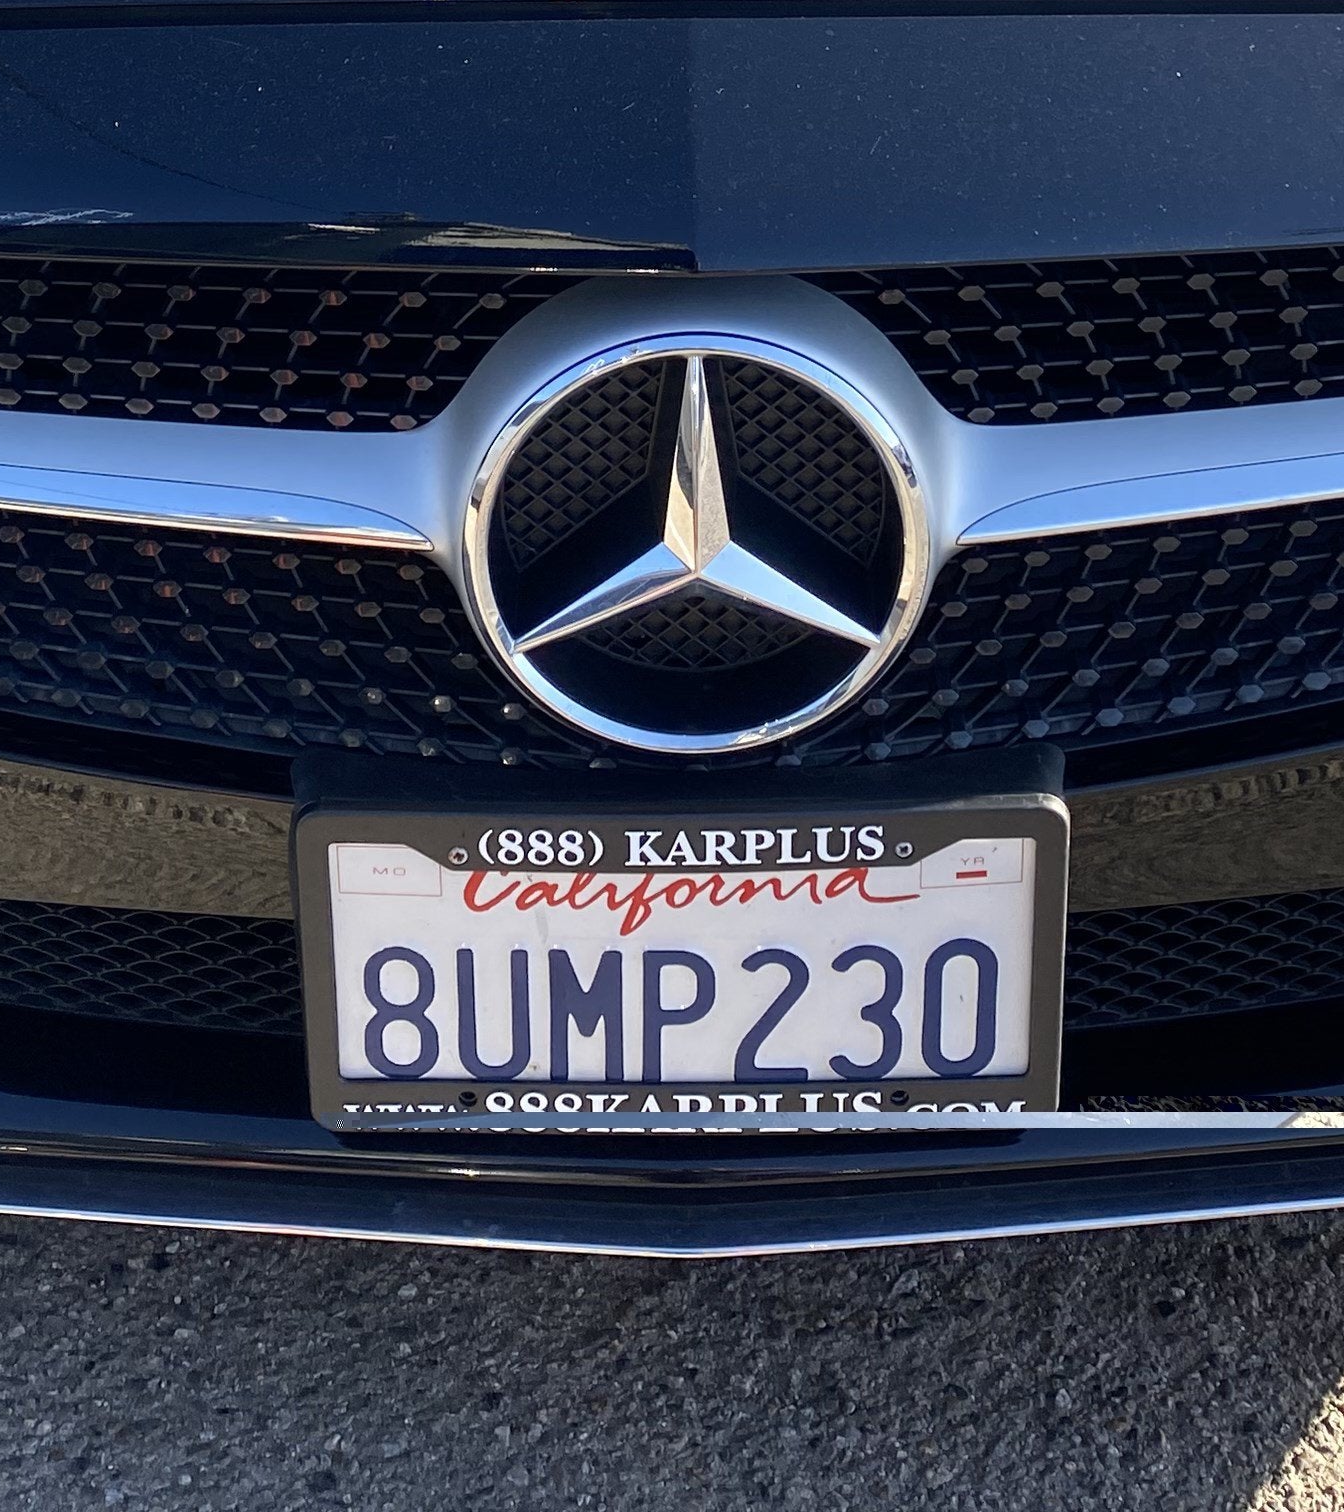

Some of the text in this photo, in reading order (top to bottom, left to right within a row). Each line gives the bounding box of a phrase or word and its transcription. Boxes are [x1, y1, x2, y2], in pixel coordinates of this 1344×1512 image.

[371, 866, 408, 877] MO
[477, 824, 886, 868] (888) KARPLUS
[462, 867, 921, 937] California
[362, 937, 1000, 1084] 8UMP230
